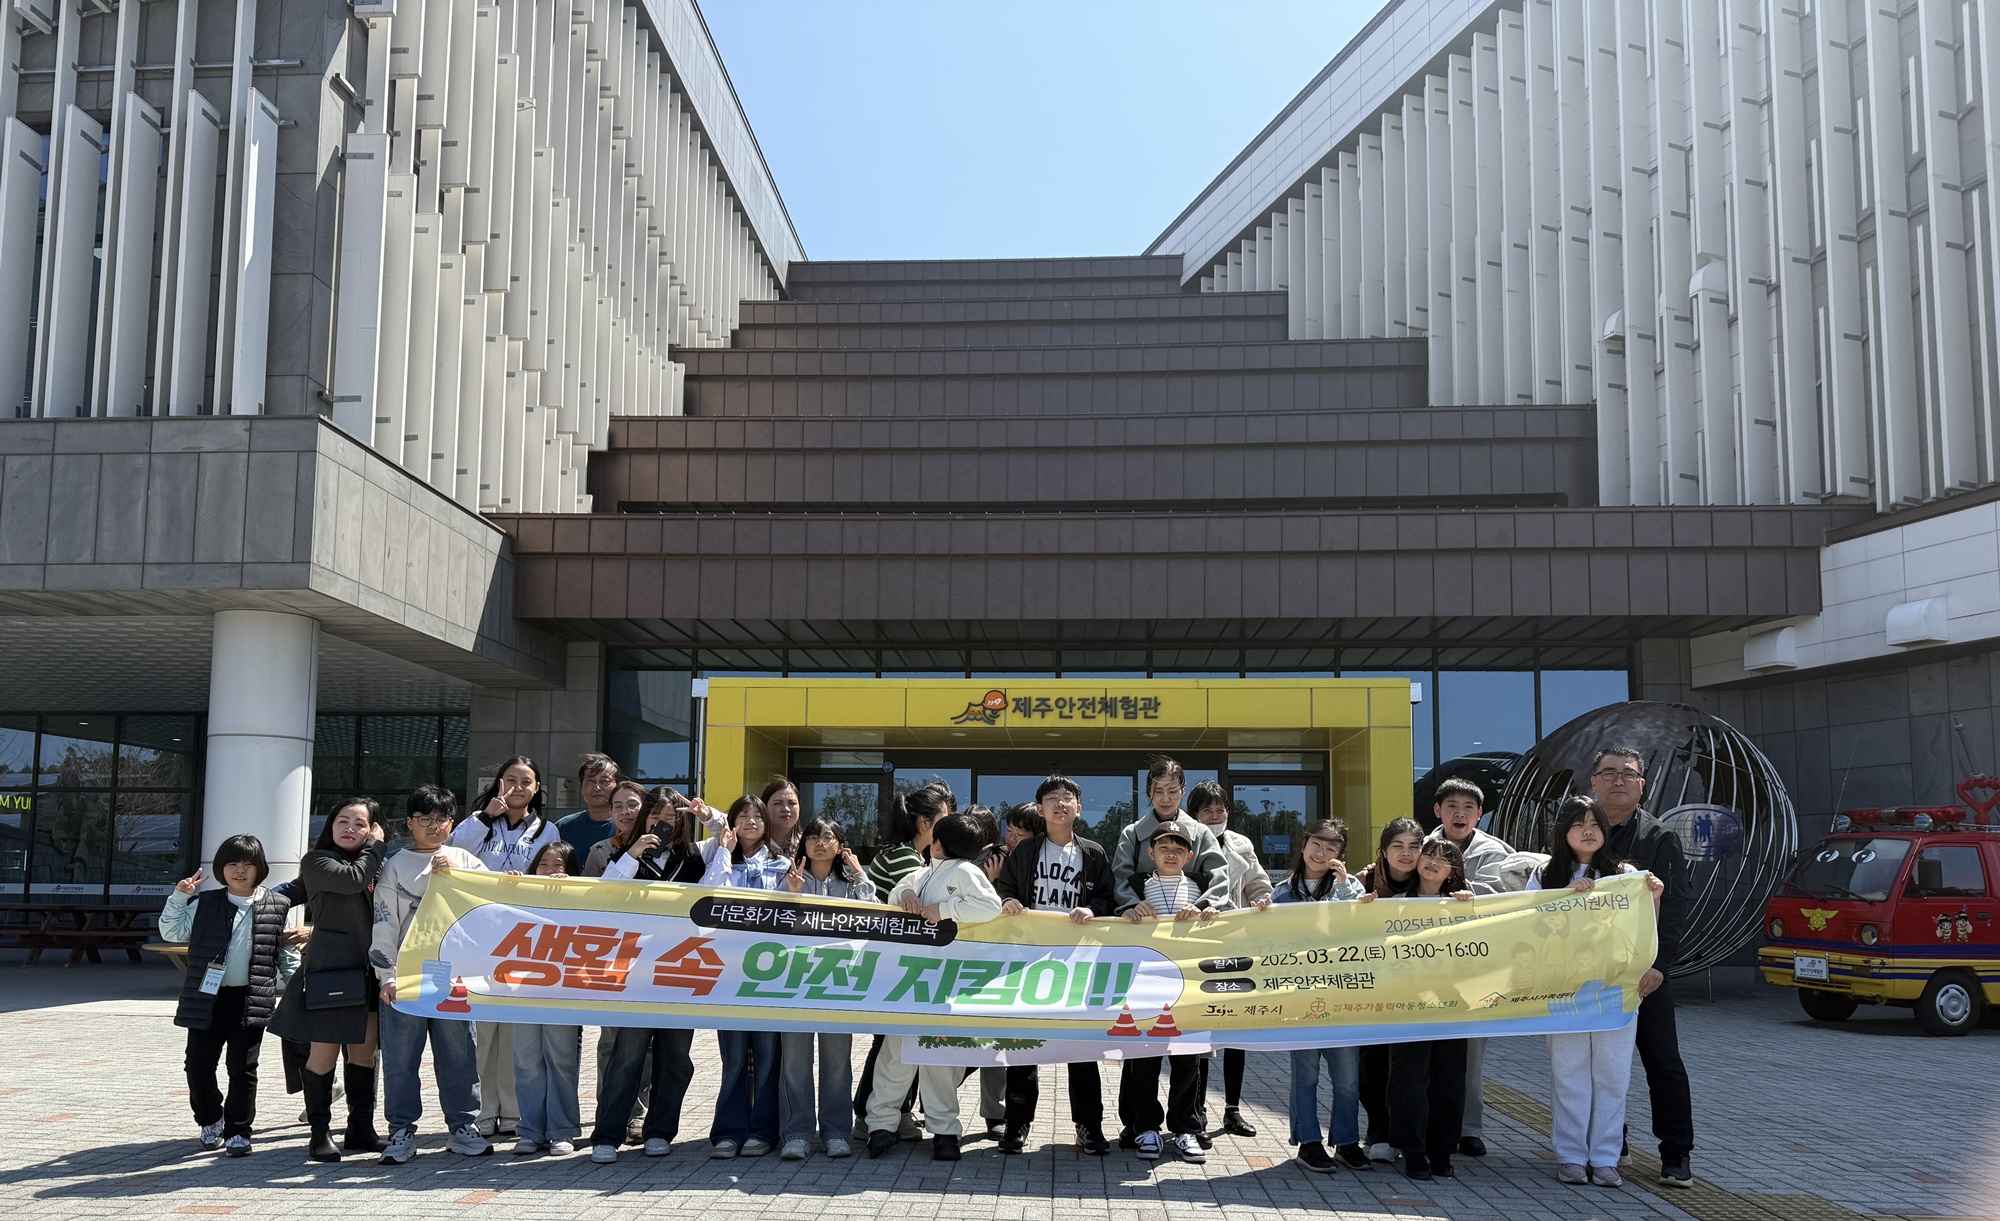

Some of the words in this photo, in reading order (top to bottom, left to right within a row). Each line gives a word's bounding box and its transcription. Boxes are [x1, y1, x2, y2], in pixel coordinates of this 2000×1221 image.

[1012, 696, 1161, 719] 제주안전체험관
[710, 904, 797, 927] 다문화가족
[801, 911, 939, 939] 재난안전체험교육
[490, 922, 643, 993] 생활
[652, 936, 726, 996] 속
[1213, 958, 1238, 969] 일시
[1306, 949, 1334, 964] 03.
[1391, 941, 1490, 960] 13:00~16:00
[735, 941, 882, 1001] 안전
[882, 954, 1134, 1007] 지킴이!!
[1262, 972, 1376, 991] 제주안전체험관
[1215, 981, 1242, 992] 장소
[1244, 1004, 1283, 1016] 제주시
